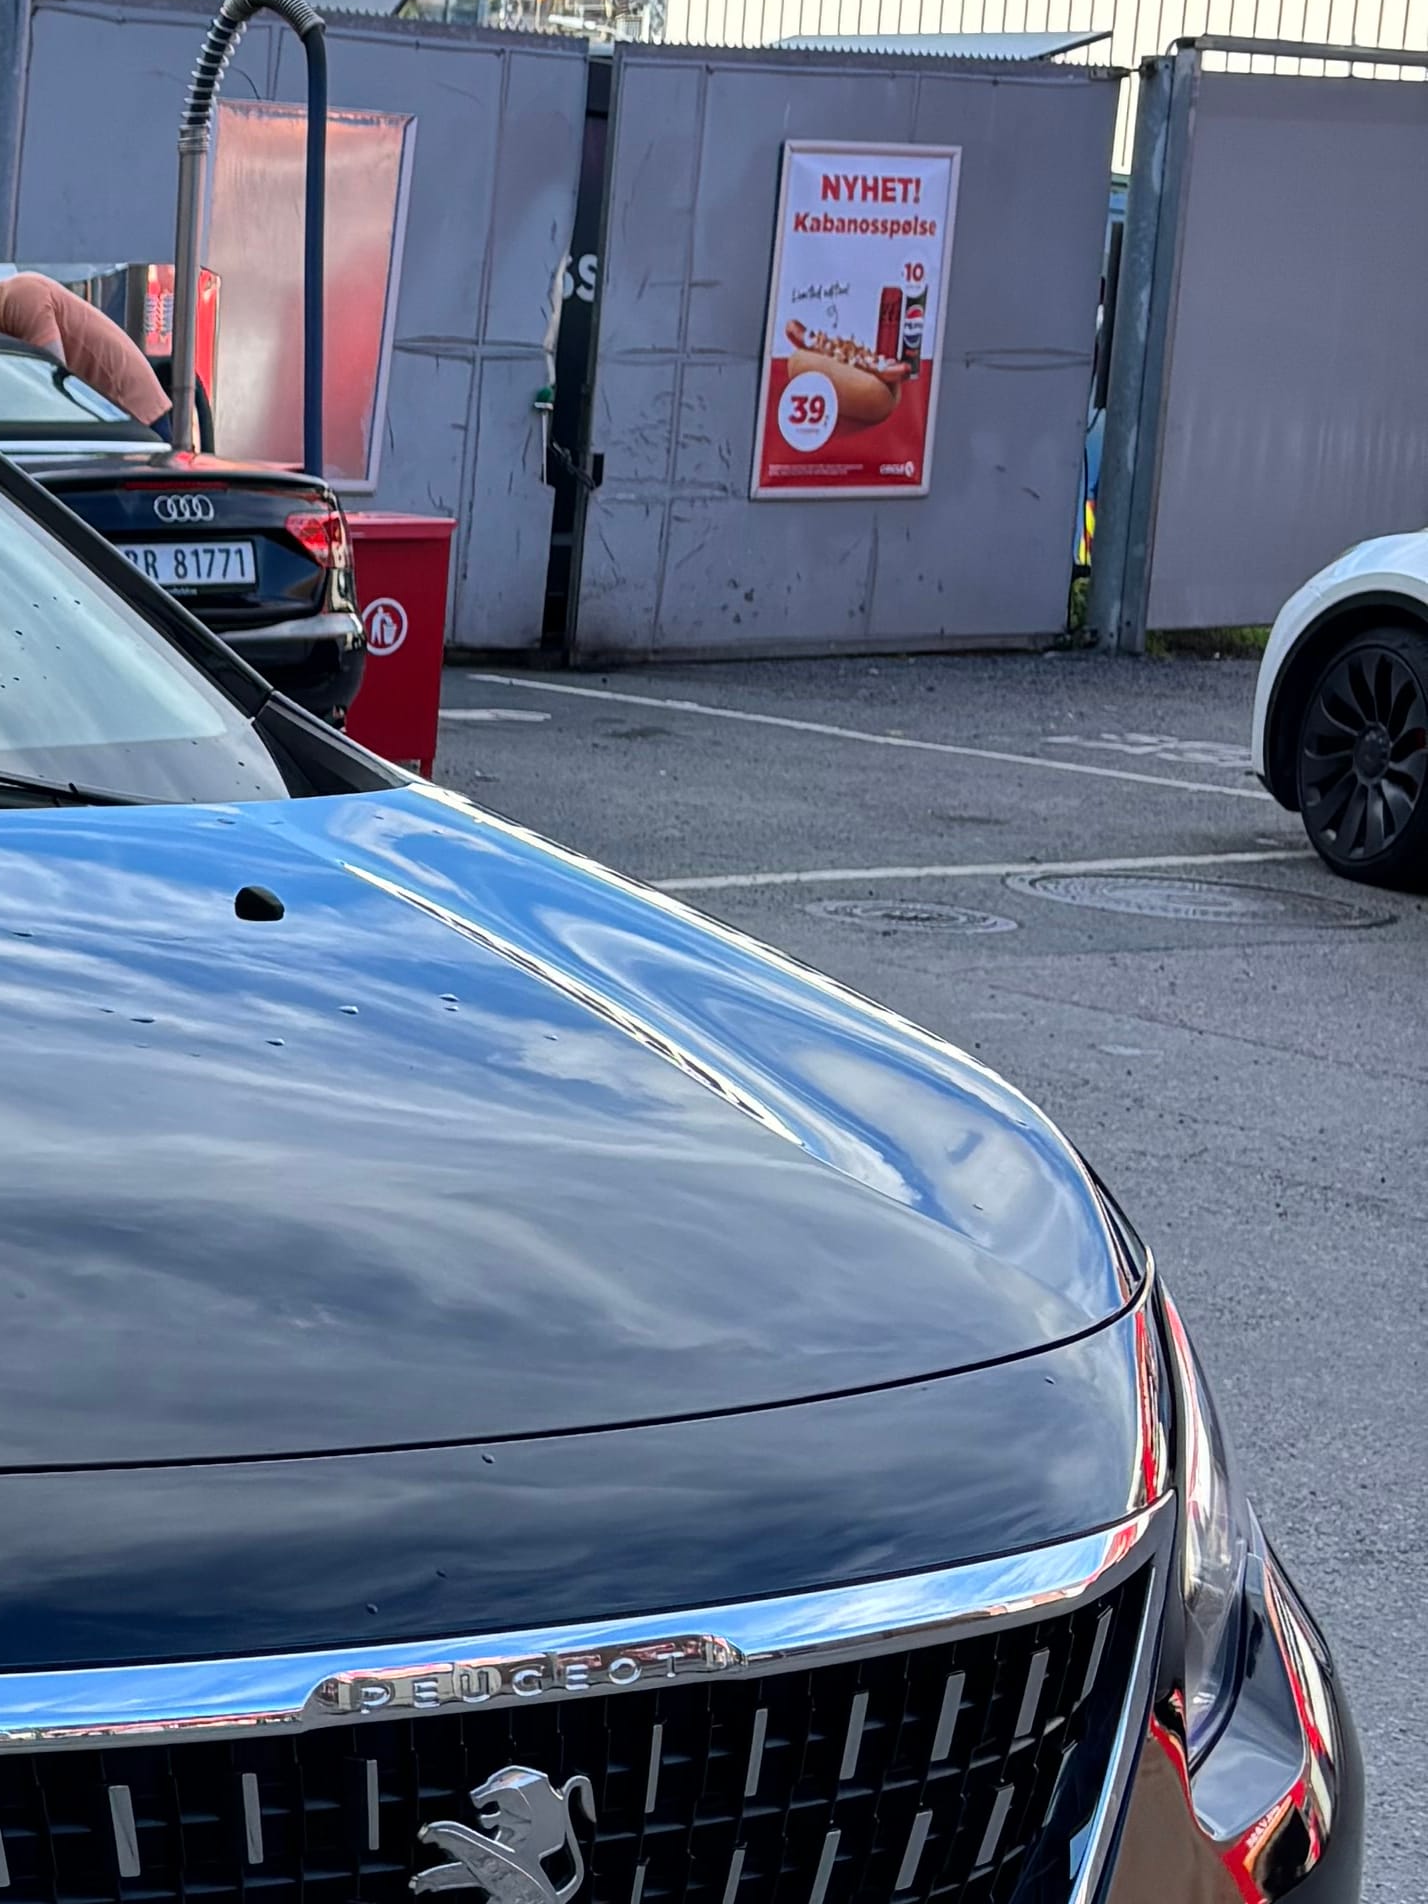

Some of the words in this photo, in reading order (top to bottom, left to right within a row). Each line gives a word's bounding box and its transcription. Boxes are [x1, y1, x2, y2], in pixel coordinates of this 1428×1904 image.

[821, 173, 921, 204] NYHET!
[793, 212, 937, 239] Kabanosspølse
[174, 548, 245, 579] 81771
[358, 1651, 684, 1713] PEUGEOT
